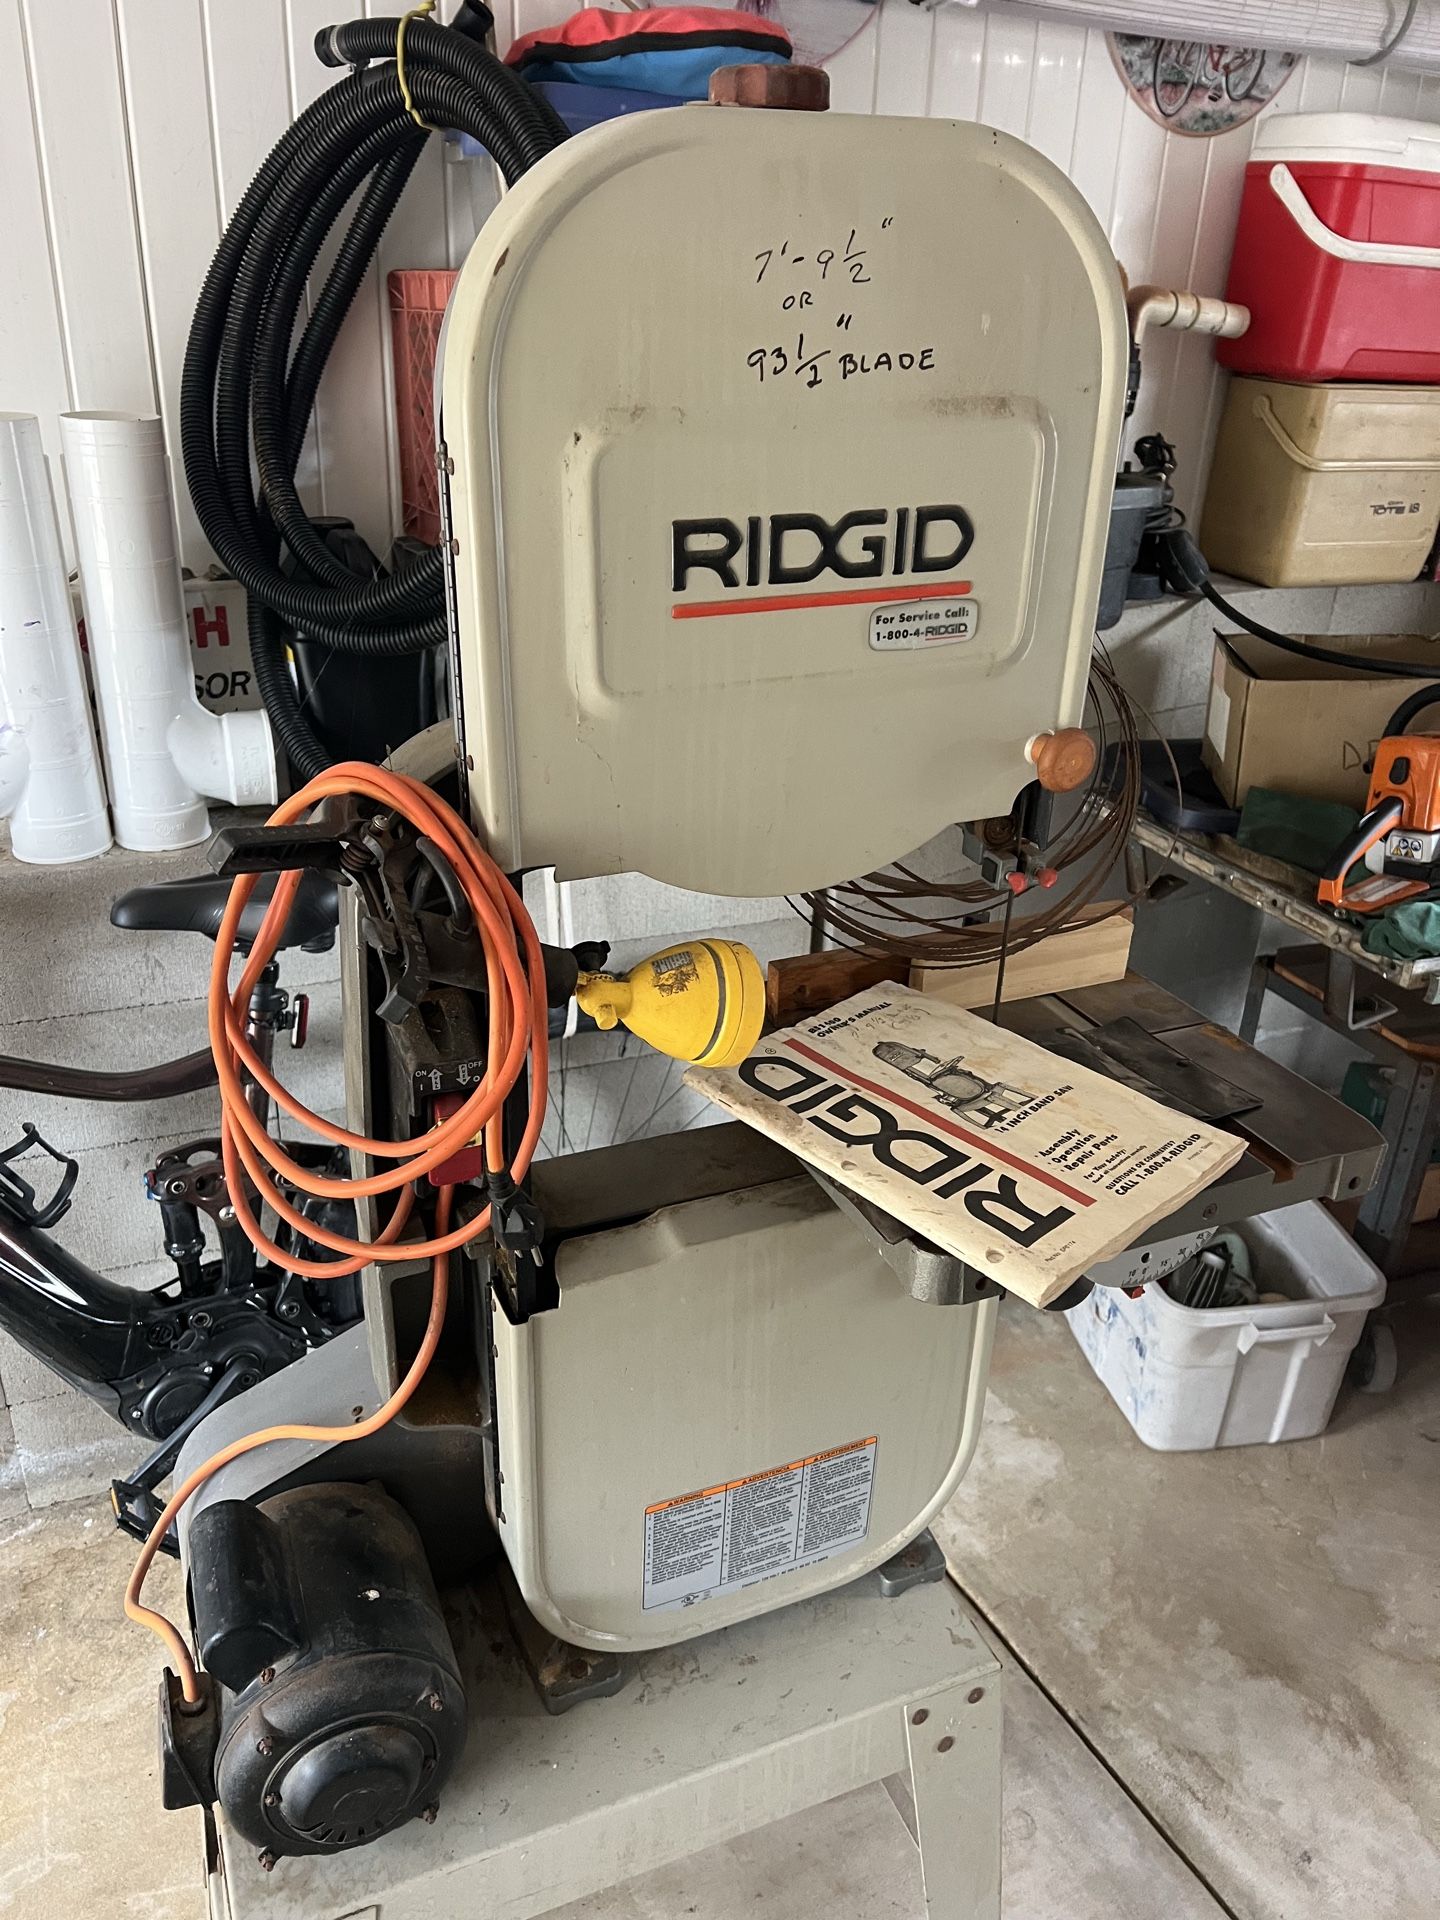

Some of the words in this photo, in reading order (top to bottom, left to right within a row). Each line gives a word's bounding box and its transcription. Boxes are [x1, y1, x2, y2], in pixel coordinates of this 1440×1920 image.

[782, 291, 813, 310] OR
[838, 348, 935, 379] BLADE
[1370, 504, 1406, 515] TOTE
[672, 504, 975, 592] RIDGID
[875, 615, 895, 635] For
[899, 610, 940, 623] Service
[945, 607, 969, 619] Call:
[817, 1017, 856, 1037] OWNER'S
[855, 1002, 892, 1019] MANUAL
[415, 1070, 427, 1078] ON
[468, 1061, 482, 1069] OFF
[1006, 1110, 1032, 1127] INCH
[1029, 1095, 1055, 1112] BAND
[1053, 1085, 1074, 1096] SAW
[738, 1056, 1076, 1248] RIDGID
[1039, 1129, 1081, 1157] Assembly
[1051, 1134, 1097, 1163] Operation
[1064, 1150, 1095, 1171] Repair
[1092, 1134, 1118, 1151] Parts
[1105, 1167, 1138, 1190] QUESTIONS
[1143, 1140, 1176, 1164] COMMENTS?
[1115, 1179, 1140, 1196] CALL
[1136, 1134, 1201, 1180] 1-800-4-RIDGID
[673, 1492, 703, 1505] WARNING
